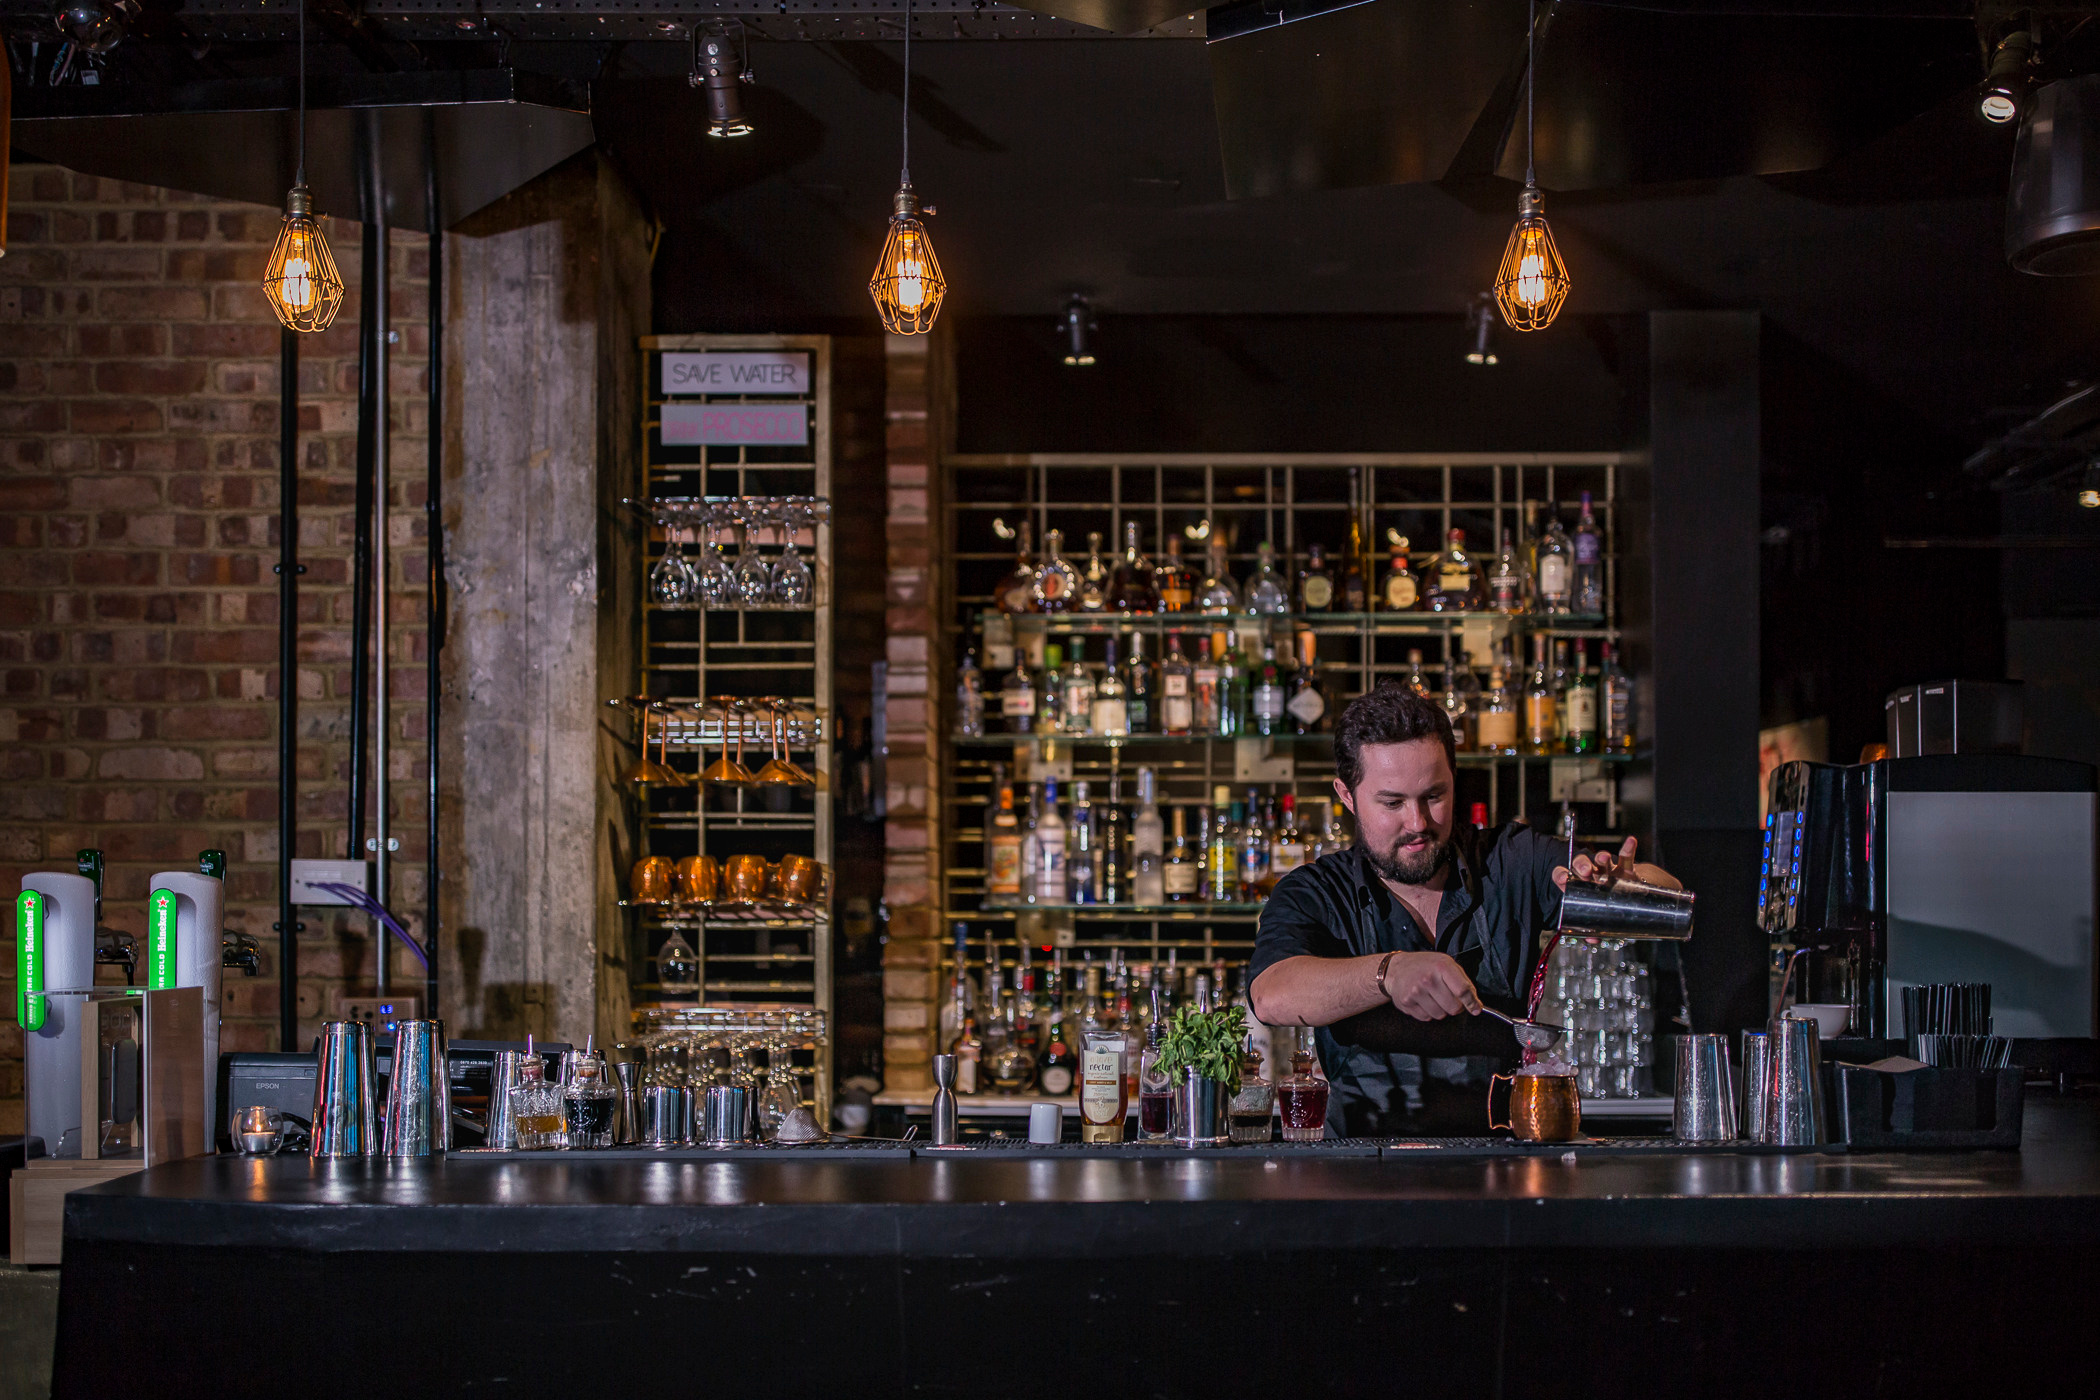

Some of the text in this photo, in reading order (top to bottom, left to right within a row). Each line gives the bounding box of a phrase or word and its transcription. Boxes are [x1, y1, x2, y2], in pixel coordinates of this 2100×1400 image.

[672, 363, 797, 384] SAVE WATER
[24, 910, 35, 952] Heineken
[157, 908, 167, 952] Heineken
